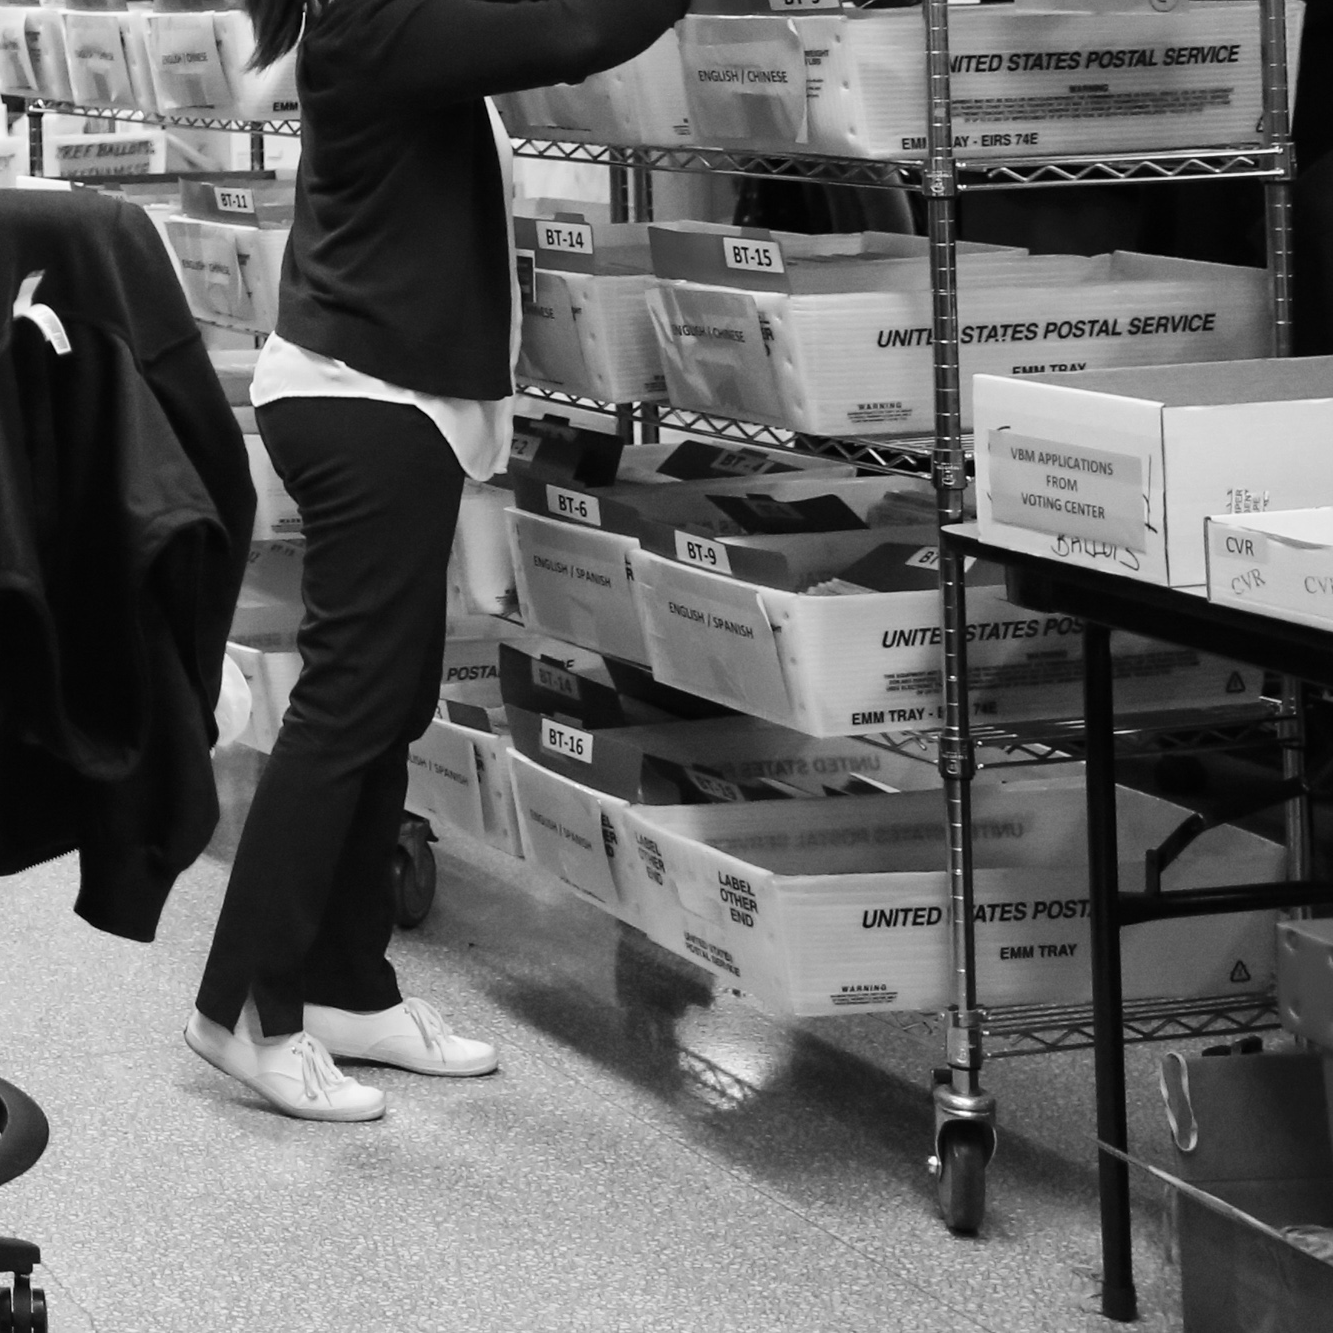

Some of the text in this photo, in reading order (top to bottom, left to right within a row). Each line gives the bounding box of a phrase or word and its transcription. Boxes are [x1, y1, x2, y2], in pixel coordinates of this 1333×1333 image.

[949, 44, 1241, 74] NITED STATES POSTAL SERVICE
[698, 68, 789, 85] ENGLISH / CHINESE
[272, 101, 299, 113] EMM
[901, 137, 926, 150] EM
[951, 136, 969, 148] AY
[981, 133, 1012, 148] EIRS
[1015, 132, 1039, 146] 74E
[220, 192, 248, 209] BT-11
[546, 229, 584, 249] BT-14
[732, 246, 773, 267] BT-15
[960, 323, 1038, 344] STATES
[1042, 318, 1122, 339] POSTAL
[1127, 313, 1217, 335] SERVICE
[857, 401, 902, 411] WARNING
[511, 438, 528, 455] T-2
[1010, 447, 1114, 477] VBM APPLICATIONS
[1045, 474, 1078, 492] FROM
[558, 494, 588, 518] BT-6
[1021, 492, 1106, 519] VOTING CENTER
[687, 540, 717, 565] BT-9
[1225, 536, 1255, 557] CVR
[533, 555, 569, 576] ENGLISH
[576, 566, 612, 588] SPANISH
[1231, 568, 1266, 595] CVR
[668, 601, 706, 624] ENGLISH
[712, 616, 754, 640] SPANISH
[881, 617, 1083, 649] UNITE STATES POS
[446, 665, 500, 682] POSTA
[851, 710, 885, 726] EMM
[888, 708, 927, 724] TRAY
[548, 727, 584, 756] BT-16
[634, 831, 662, 857] LABEL
[638, 847, 666, 874] OTHER
[646, 868, 664, 886] END
[718, 871, 756, 898] LABEL
[719, 888, 759, 914] OTHER
[729, 907, 754, 928] END
[861, 899, 1090, 929] UNITED ATES POST
[999, 943, 1078, 961] EMM TRAY
[841, 982, 888, 993] WARNING
